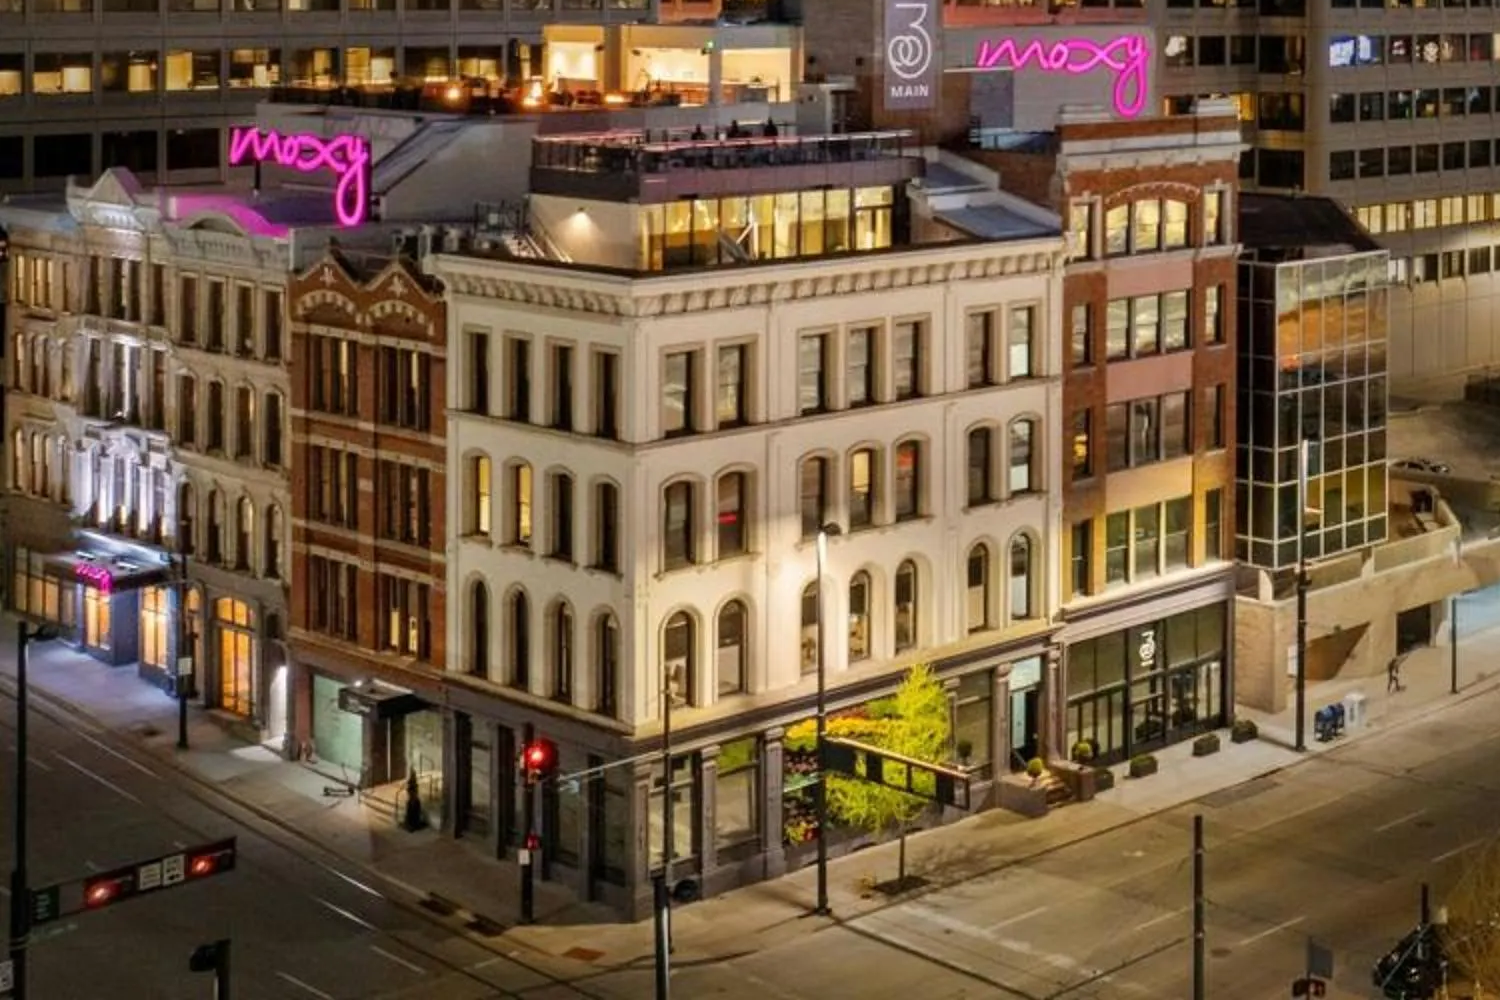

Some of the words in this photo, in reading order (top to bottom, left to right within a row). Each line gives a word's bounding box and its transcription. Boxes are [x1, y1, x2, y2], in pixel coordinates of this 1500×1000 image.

[890, 84, 930, 98] MAIN
[977, 33, 1150, 118] moxy
[229, 126, 369, 226] moxy
